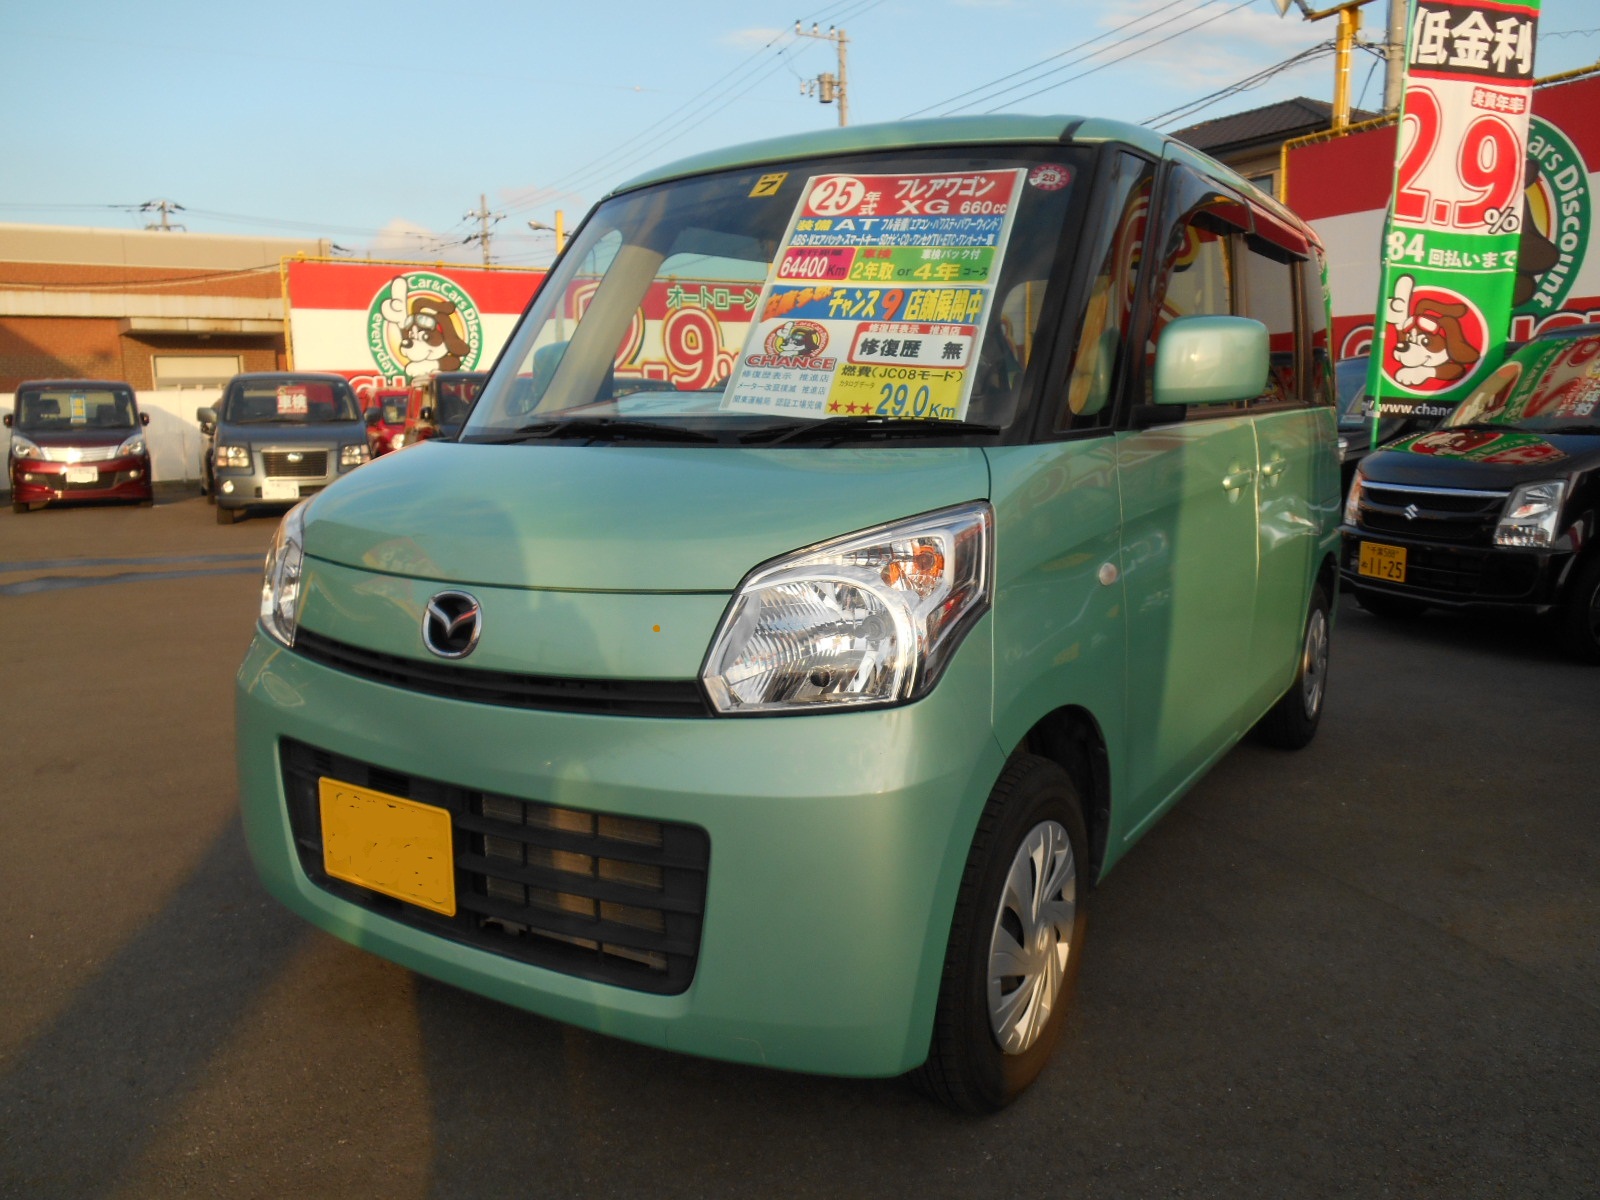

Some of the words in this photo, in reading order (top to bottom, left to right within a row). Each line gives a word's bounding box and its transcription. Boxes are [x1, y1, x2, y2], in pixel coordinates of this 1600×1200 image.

[1410, 6, 1533, 74] 低金利
[1472, 88, 1525, 113] 実質年率
[1042, 173, 1056, 182] 28
[816, 180, 857, 211] 25
[894, 176, 997, 199] フレアワゴン
[896, 199, 949, 214] XG
[959, 201, 1008, 214] 660cc
[833, 218, 879, 231] AT
[1533, 164, 1584, 308] Discount
[1387, 230, 1425, 262] 84
[1428, 248, 1517, 268] 回払いまで
[781, 256, 828, 278] 64400
[897, 267, 912, 277] or
[913, 262, 961, 280] 4年
[963, 267, 988, 277] コース
[666, 285, 760, 311] オートローン
[828, 288, 881, 318] チャンス
[881, 288, 905, 320] 9
[371, 313, 398, 376] everyday
[859, 337, 922, 358] 修復歴
[941, 341, 963, 360] 無
[745, 354, 837, 371] CHANCE
[875, 382, 931, 416] 29.0
[928, 404, 957, 417] Km
